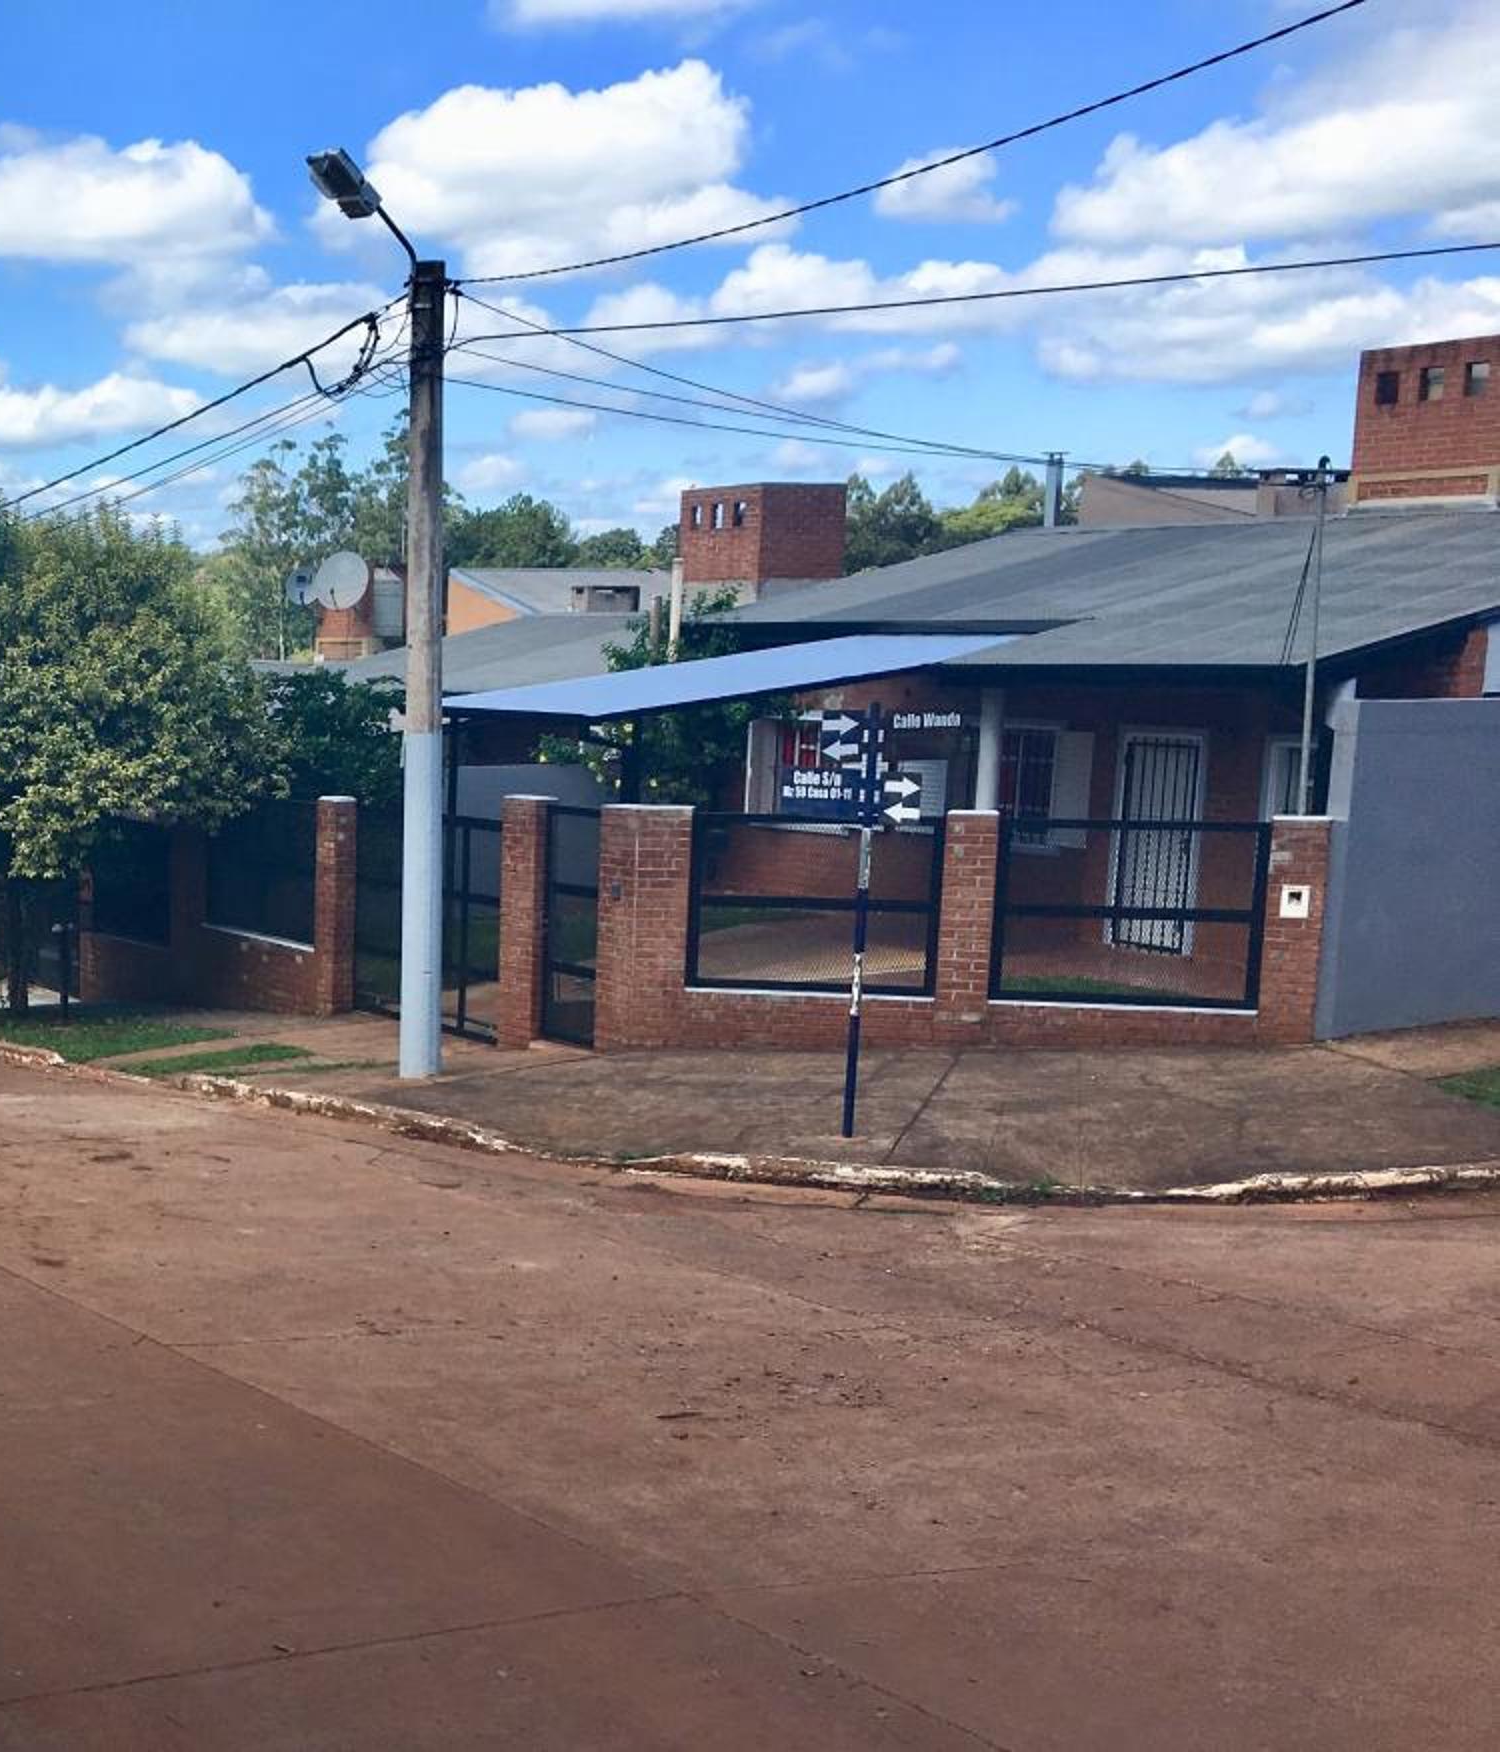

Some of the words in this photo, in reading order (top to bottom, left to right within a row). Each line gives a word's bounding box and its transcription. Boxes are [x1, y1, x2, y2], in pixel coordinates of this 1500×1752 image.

[893, 713, 921, 729] Calle
[924, 712, 961, 727] Wanda
[793, 770, 820, 785] Calle
[822, 771, 842, 786] S/n
[808, 786, 828, 799] Casa
